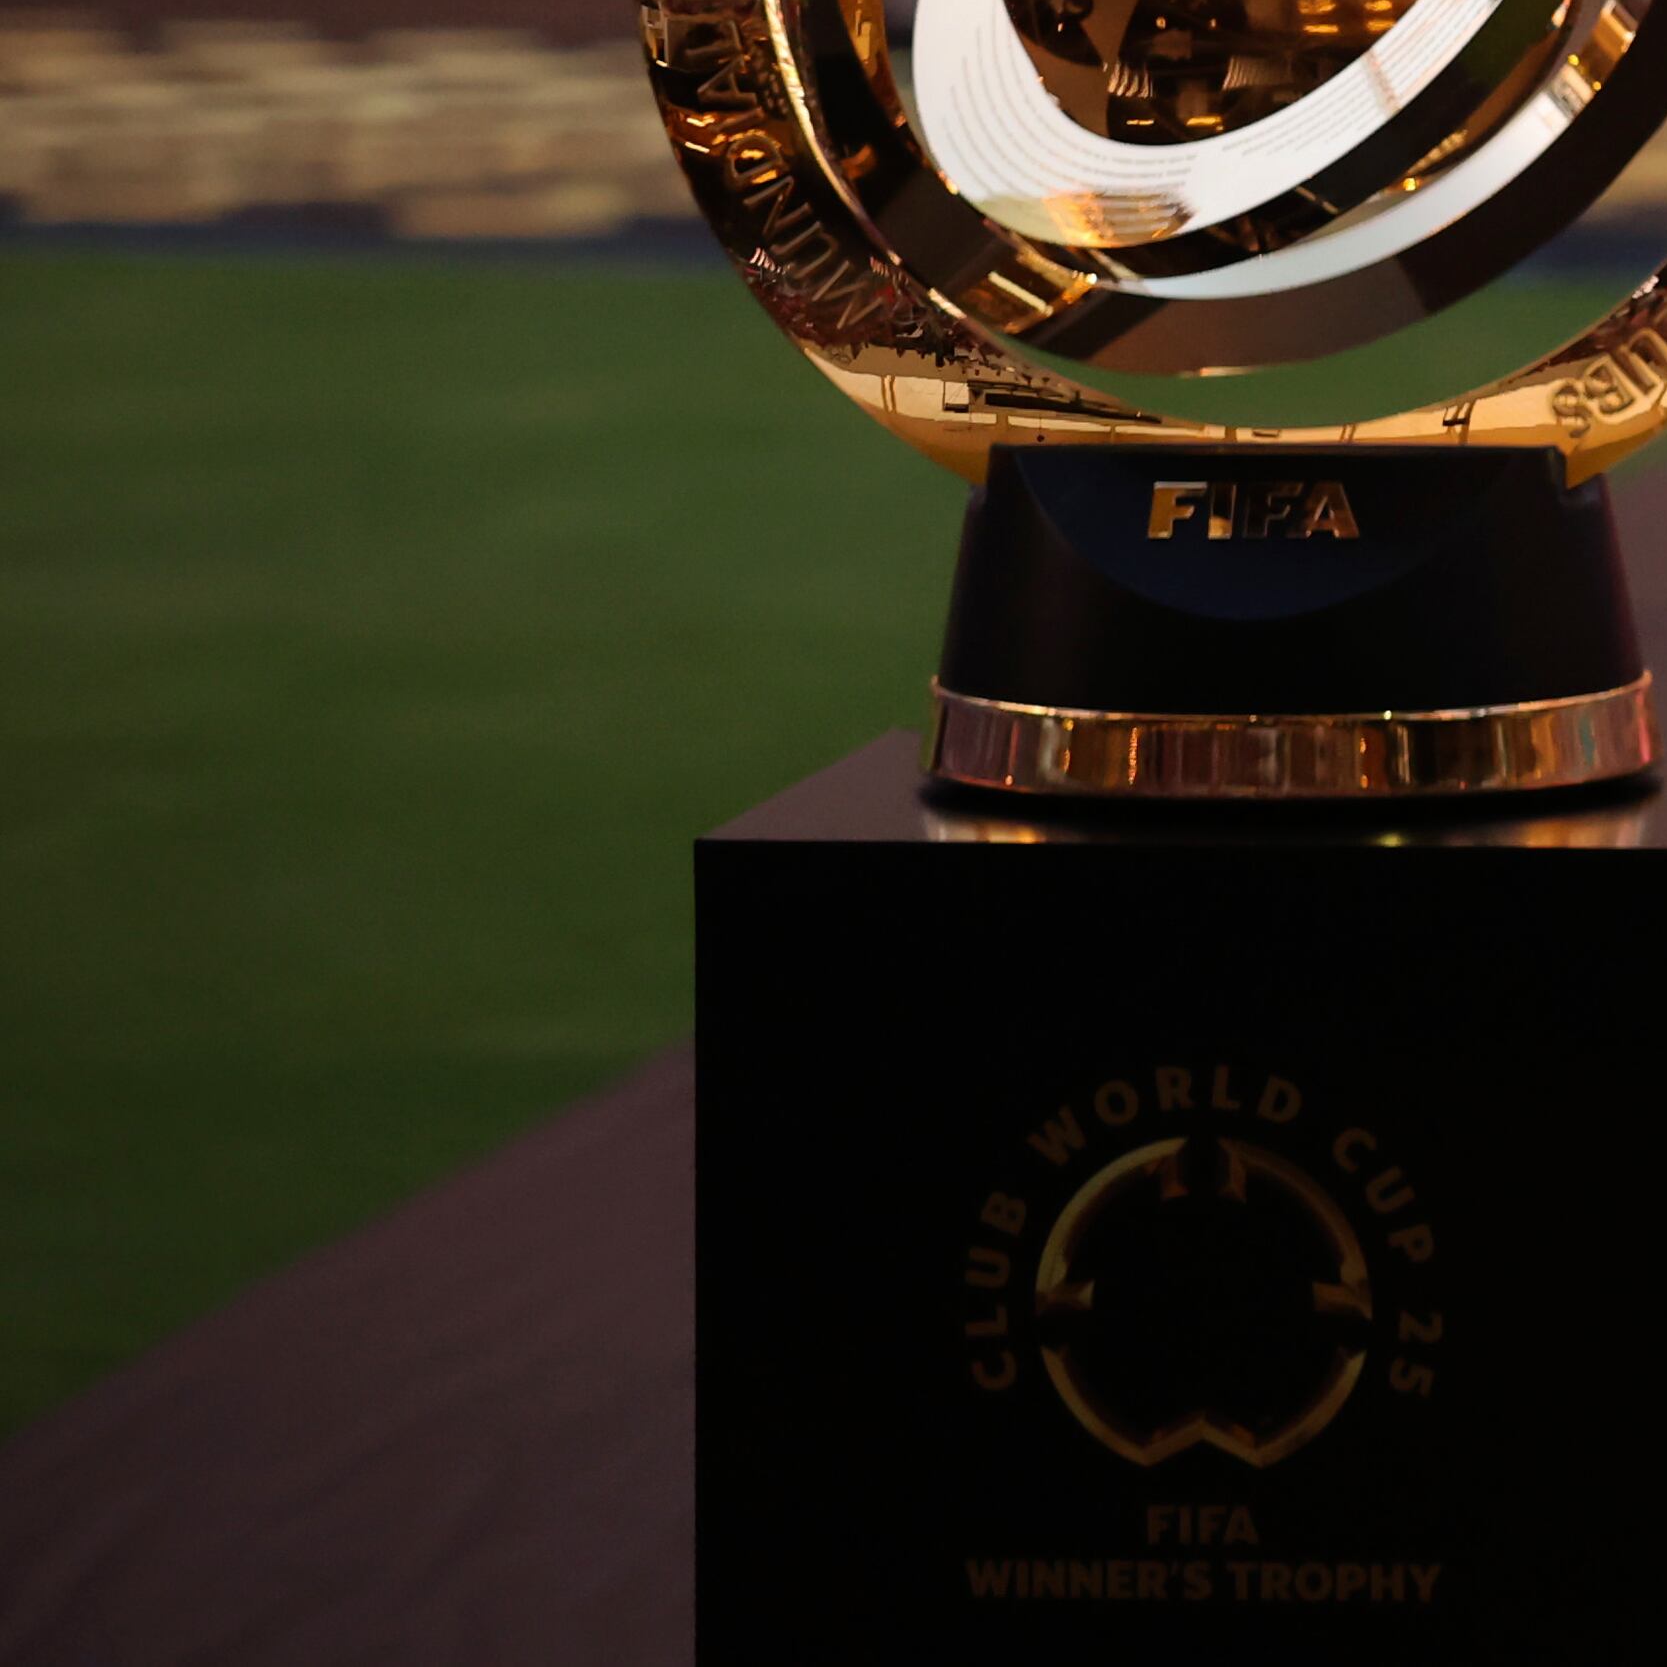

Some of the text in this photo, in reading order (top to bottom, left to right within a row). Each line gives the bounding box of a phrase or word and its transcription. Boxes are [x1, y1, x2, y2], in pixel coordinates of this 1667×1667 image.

[684, 18, 887, 330] MUNDIAL
[1147, 481, 1359, 540] FIFA
[965, 1065, 1443, 1398] CLUB WORLD CUP 25
[1146, 1505, 1259, 1545] FIFA
[964, 1560, 1443, 1604] WINNER'S TROPHY
